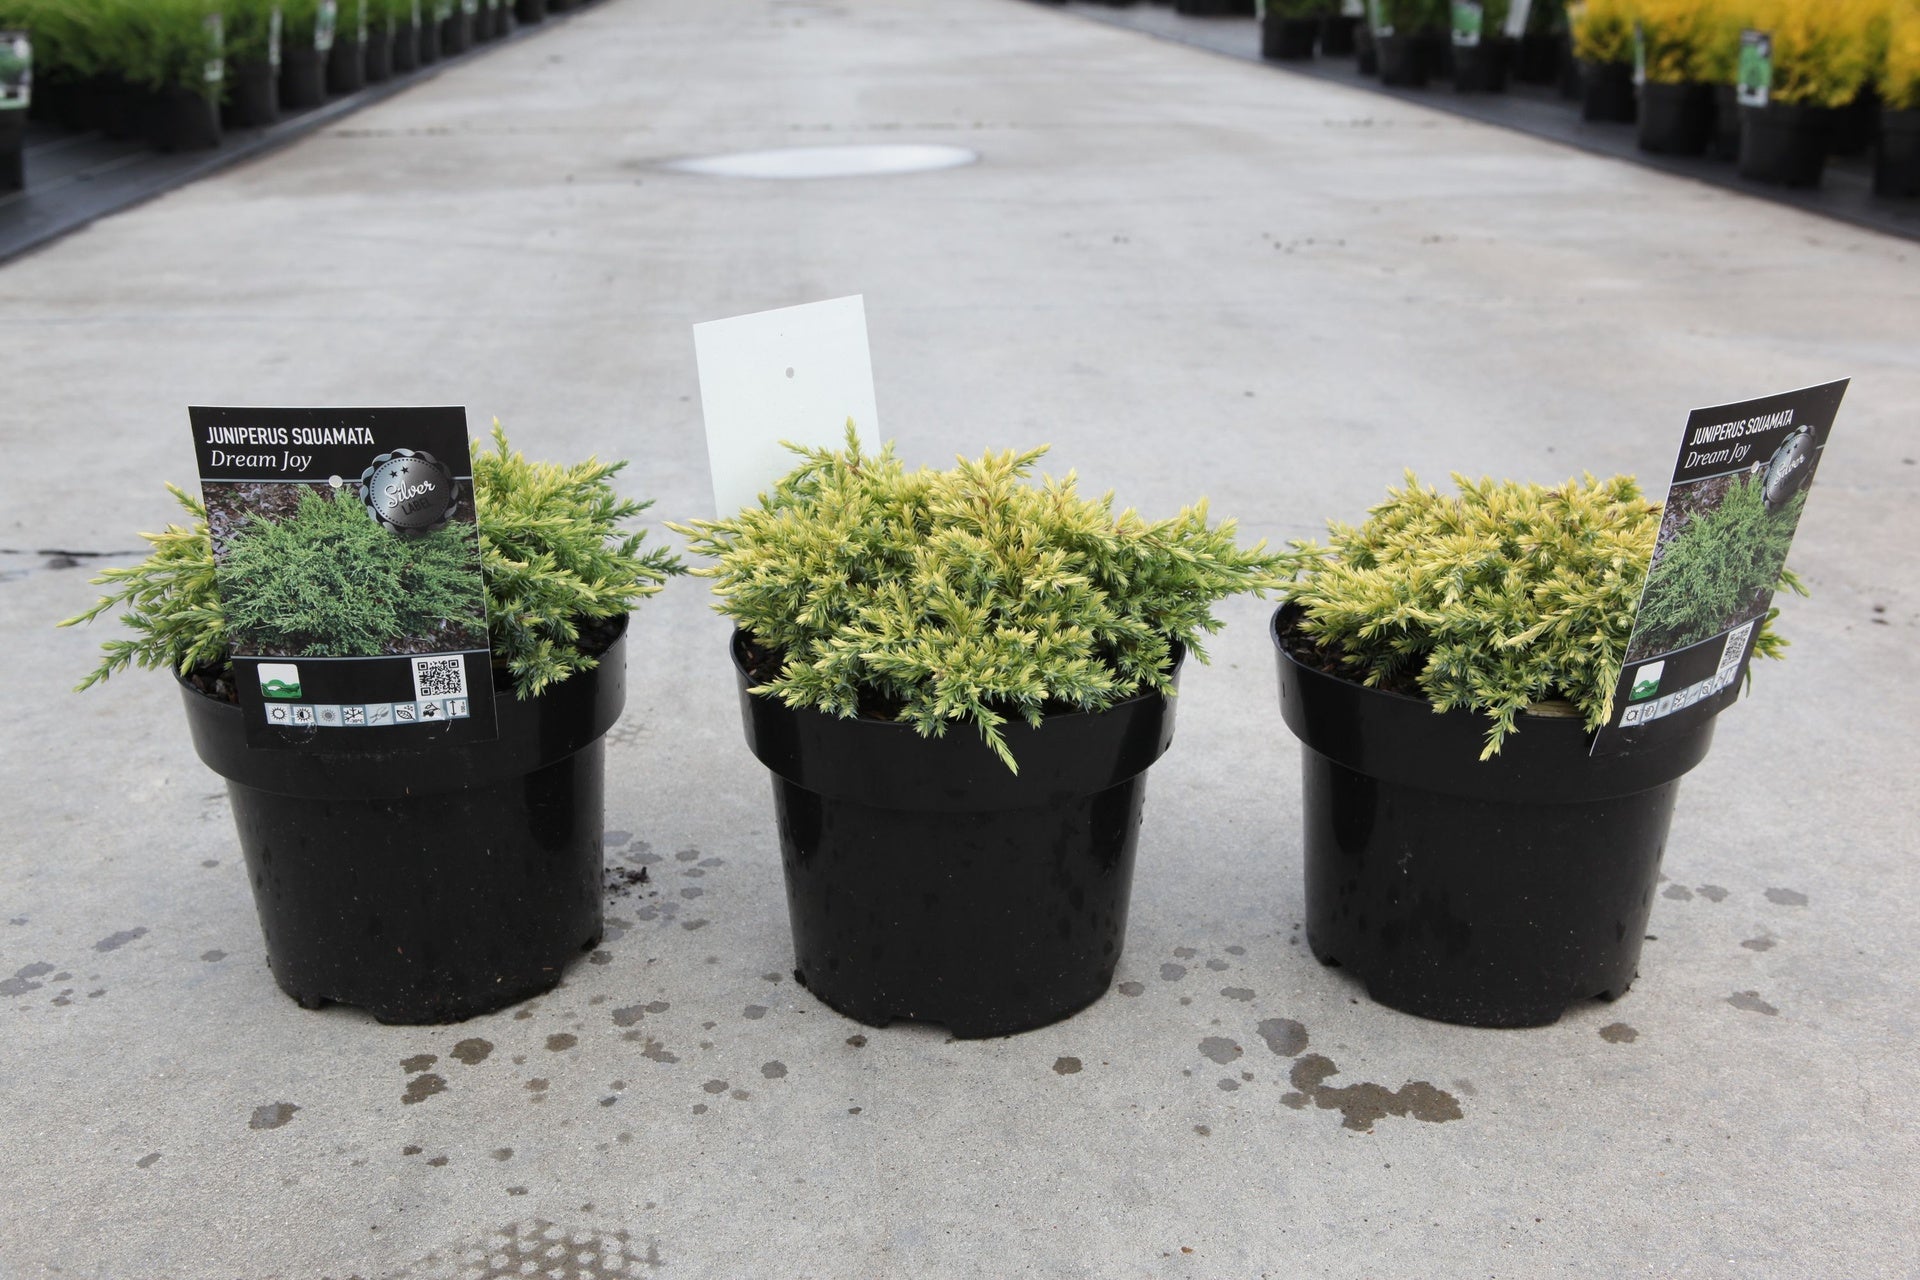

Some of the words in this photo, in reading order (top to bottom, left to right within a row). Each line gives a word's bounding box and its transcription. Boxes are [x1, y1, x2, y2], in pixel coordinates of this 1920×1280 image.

[206, 426, 289, 445] JUNIPERUS
[292, 427, 375, 445] SQUAMATA
[1689, 420, 1747, 446] JUNIPERUS
[1745, 409, 1794, 435] SQUAMATA
[211, 450, 277, 467] Dream
[280, 451, 312, 472] Joy
[1684, 448, 1730, 469] Dream
[1727, 443, 1752, 464] Joy
[1774, 454, 1806, 484] Silver
[384, 480, 436, 508] Silver
